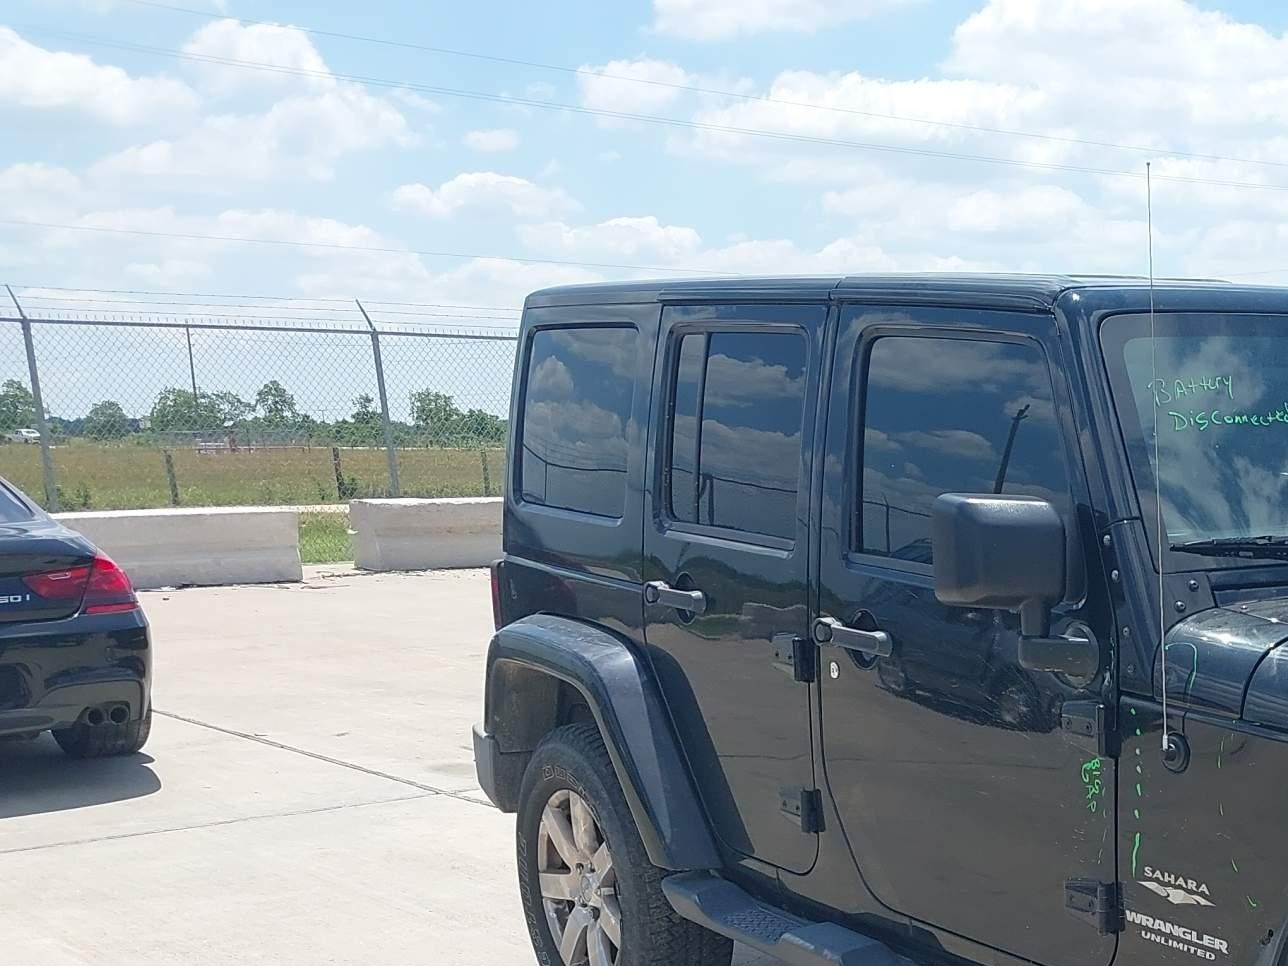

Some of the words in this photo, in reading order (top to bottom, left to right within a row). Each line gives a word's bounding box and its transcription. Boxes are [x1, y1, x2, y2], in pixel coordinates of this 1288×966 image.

[1143, 865, 1210, 896] SAHARA
[1125, 909, 1229, 954] WRANGLER
[1141, 930, 1216, 961] UNLIMITED
